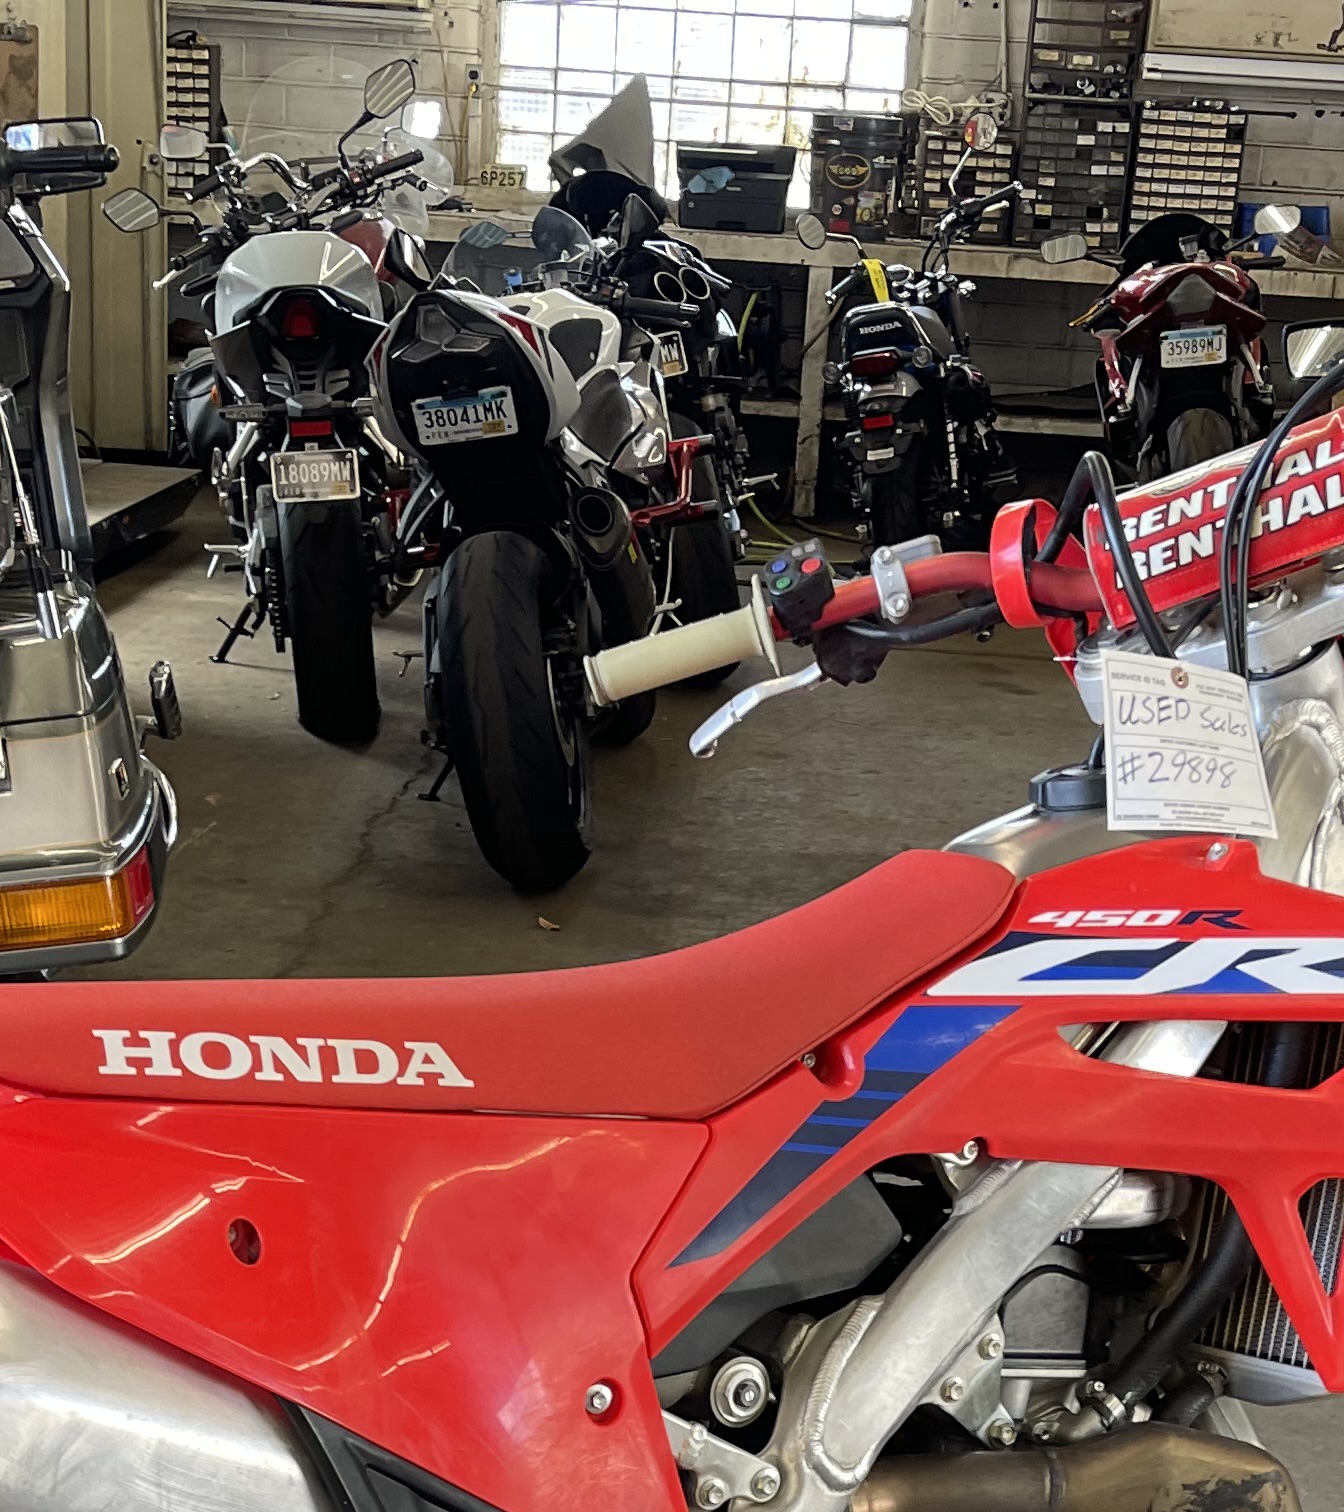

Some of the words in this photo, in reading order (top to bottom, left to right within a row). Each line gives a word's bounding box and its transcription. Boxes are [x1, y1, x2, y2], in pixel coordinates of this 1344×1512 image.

[481, 171, 524, 186] 6P257
[859, 321, 902, 334] HONDA
[1168, 337, 1222, 356] 35989MJ
[422, 400, 507, 428] 38041MK
[279, 461, 350, 484] 18089MW
[1119, 693, 1191, 726] USED
[1200, 706, 1247, 738] Sales
[1118, 751, 1237, 788] #29898
[1028, 908, 1248, 930] 450R
[92, 1029, 475, 1088] HONDA
